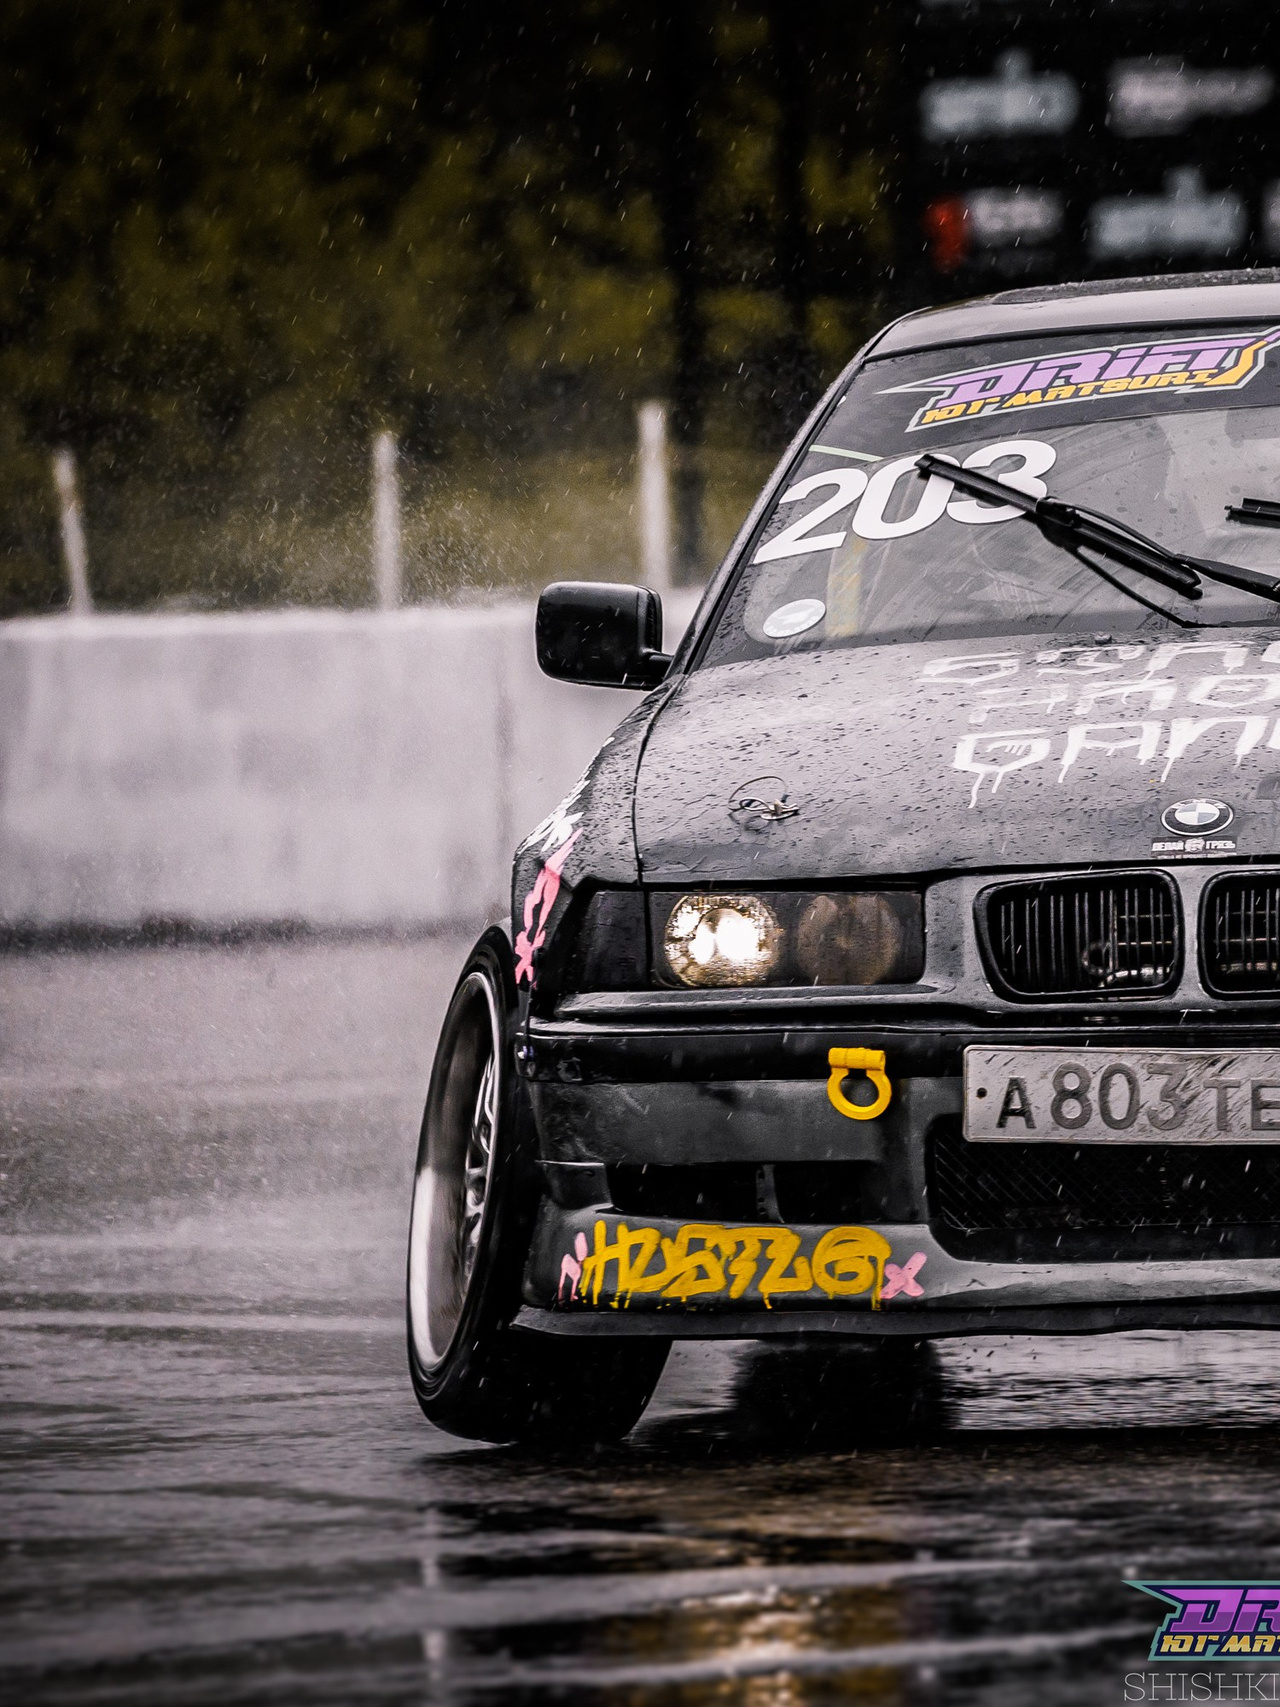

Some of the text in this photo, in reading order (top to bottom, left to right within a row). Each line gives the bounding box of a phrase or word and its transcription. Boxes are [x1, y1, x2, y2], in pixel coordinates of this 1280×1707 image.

[927, 336, 1258, 407] DRIFT
[1004, 369, 1219, 408] MATSURI
[752, 439, 1057, 564] 203
